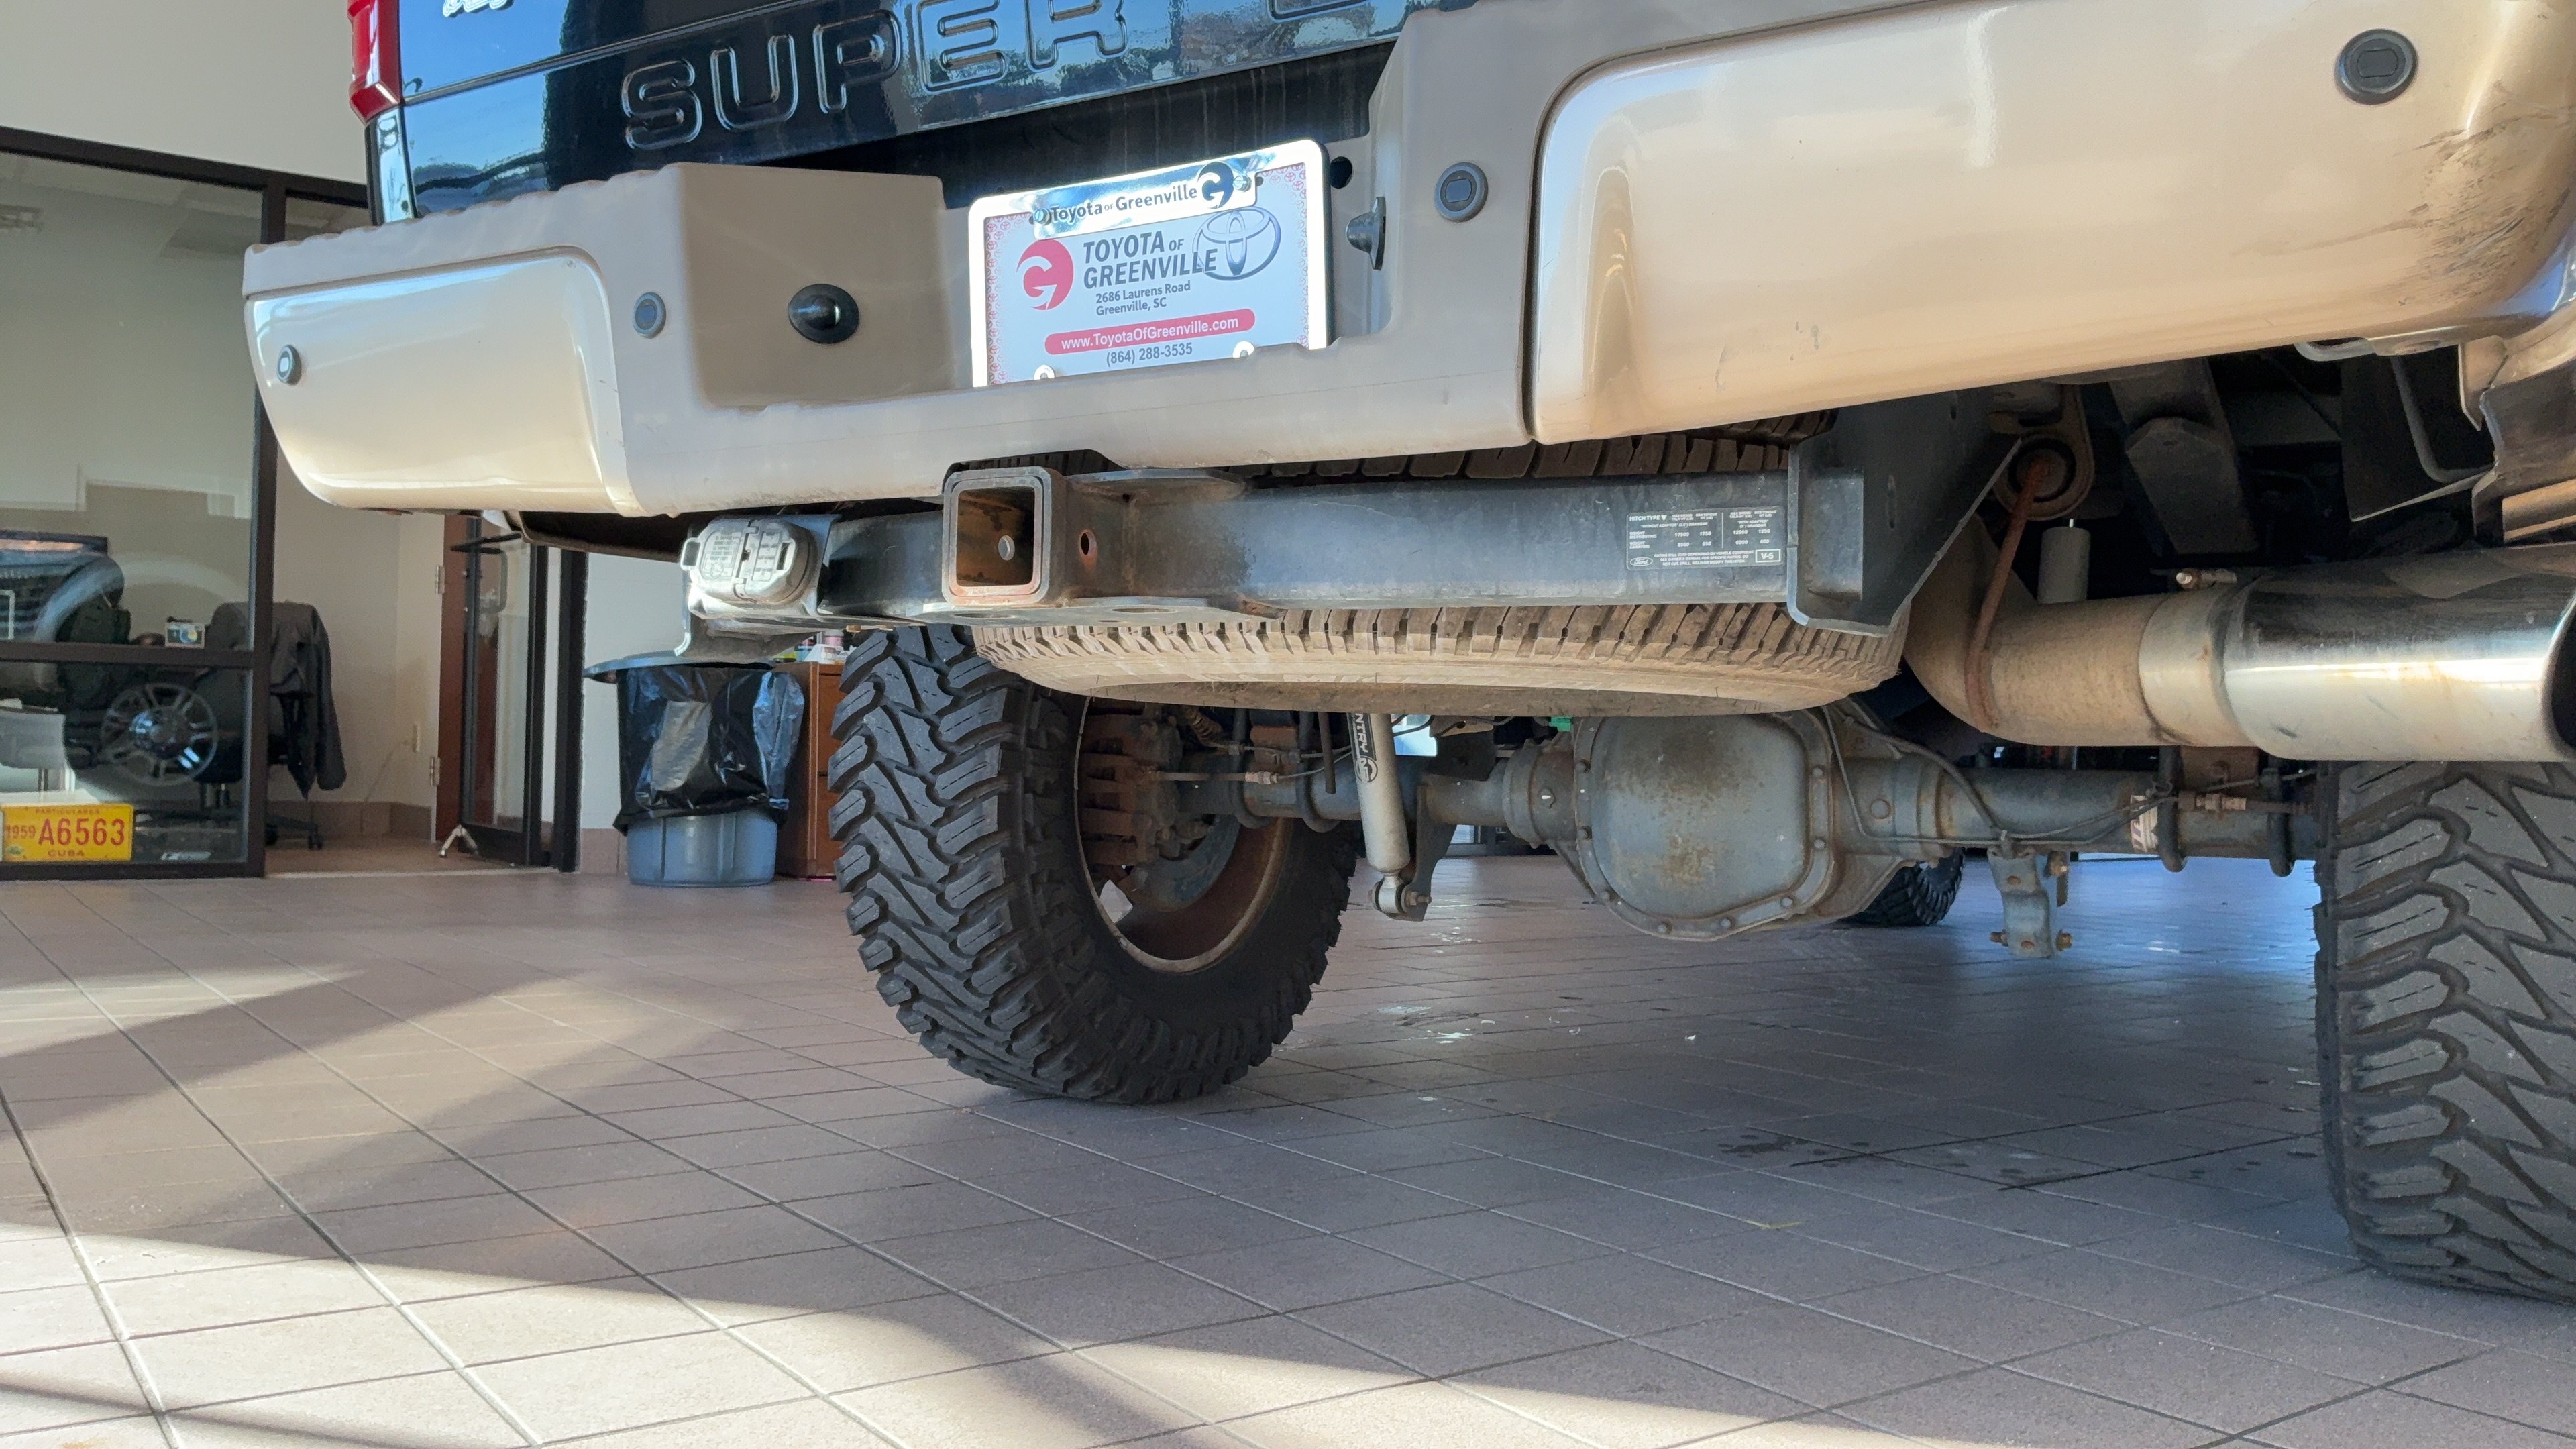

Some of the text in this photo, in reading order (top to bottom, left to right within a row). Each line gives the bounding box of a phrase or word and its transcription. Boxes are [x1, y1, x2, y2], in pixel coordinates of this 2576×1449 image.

[621, 0, 1128, 150] SUPER
[1051, 203, 1102, 223] Toyota
[1116, 184, 1197, 211] Greenville
[1083, 231, 1184, 263] TOYOTA OF
[1084, 248, 1218, 288] GREENVILLE
[1096, 280, 1191, 303] 2686 Laurens Road
[1097, 297, 1167, 315] Greenville, SC
[1061, 317, 1238, 349] www.ToyotaOfGreenville.com
[1107, 343, 1192, 367] (864) 288-3535
[38, 818, 125, 845] A6563
